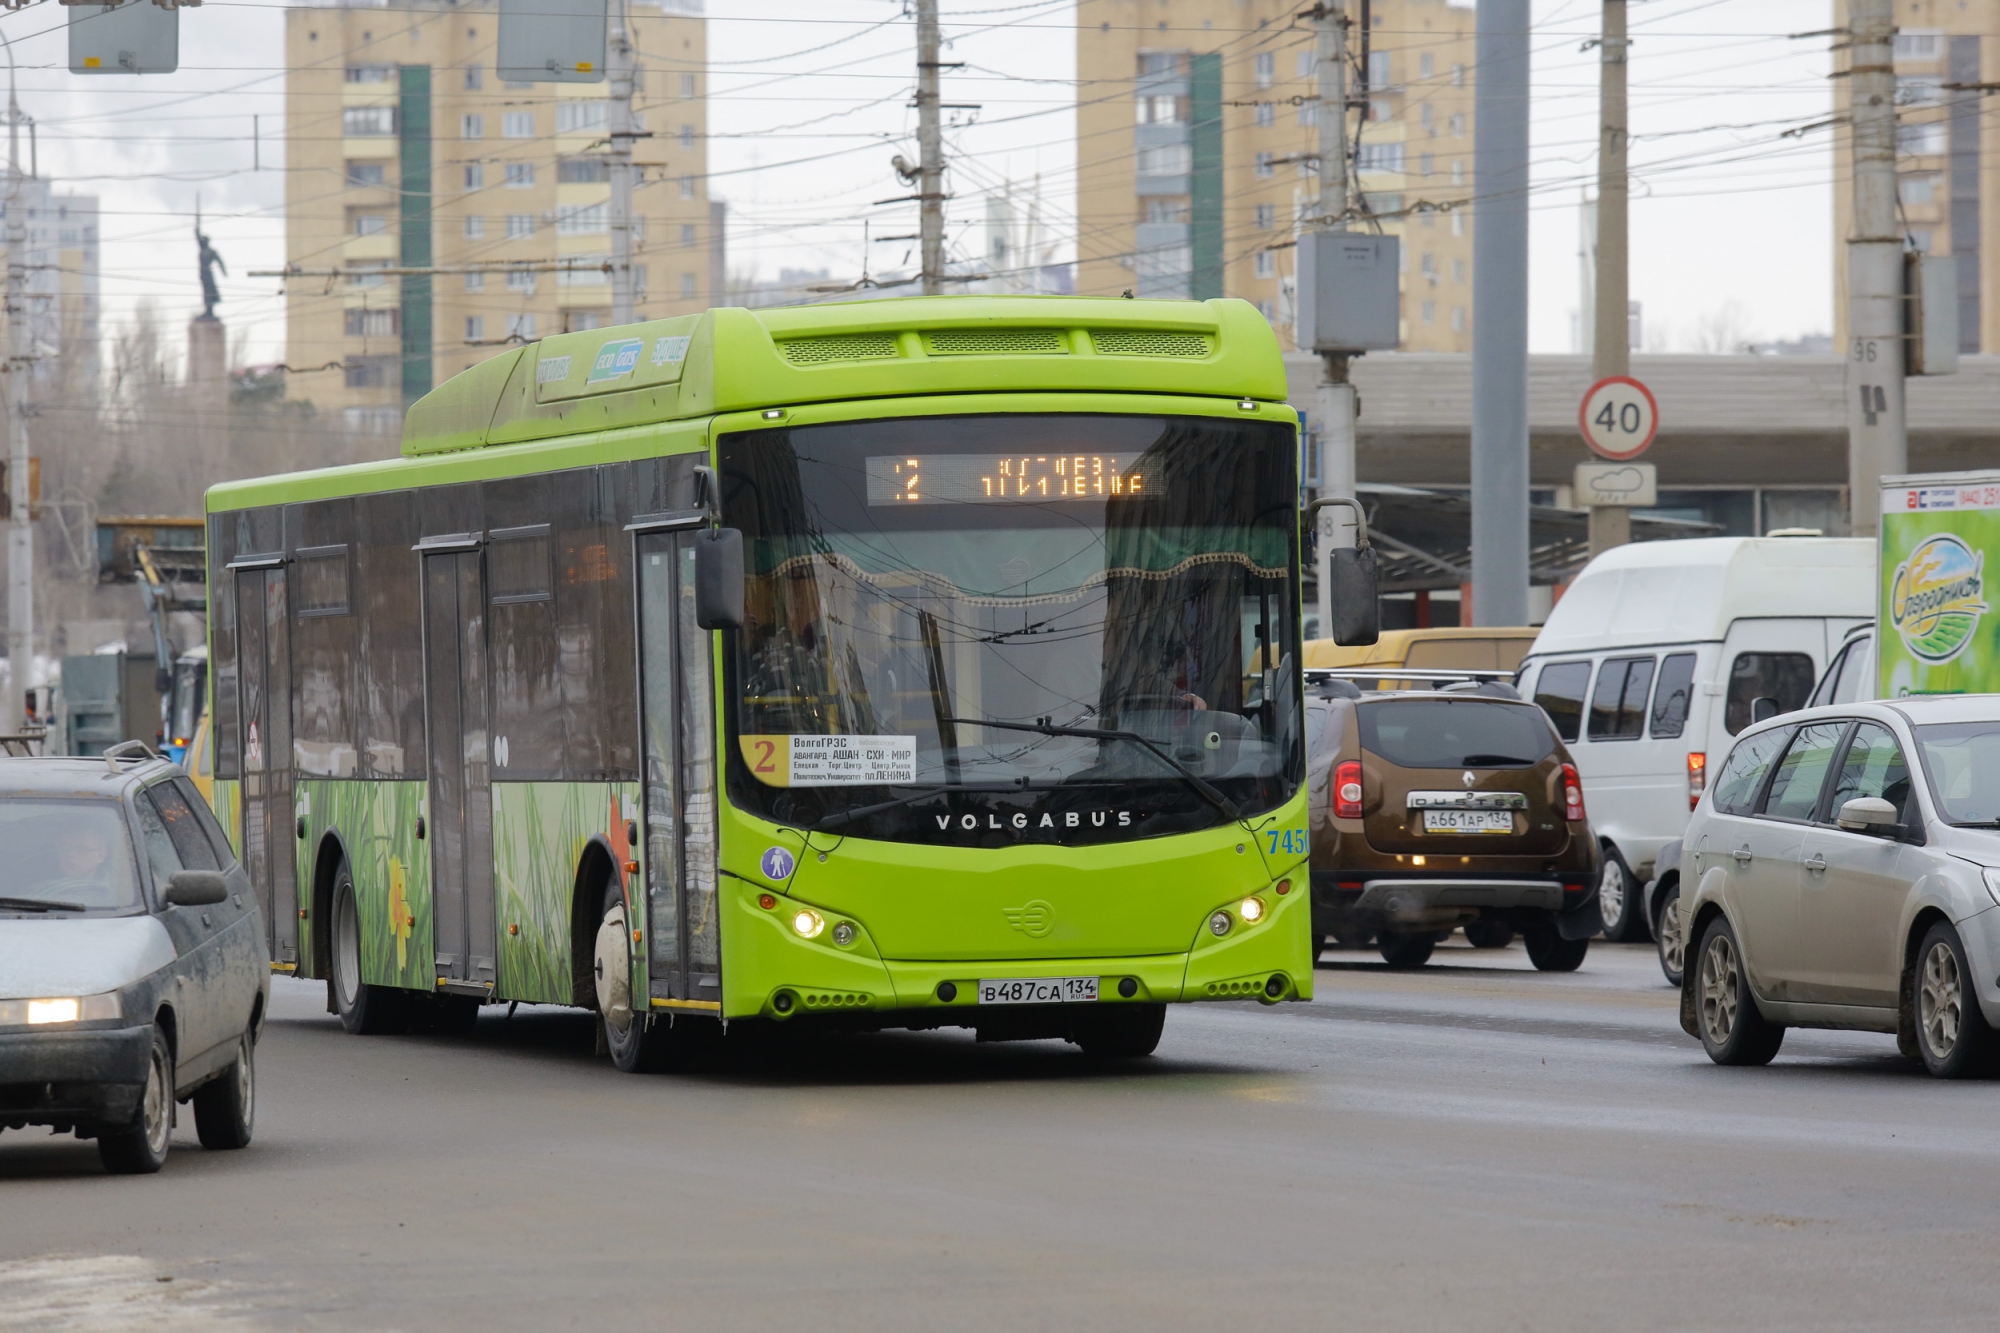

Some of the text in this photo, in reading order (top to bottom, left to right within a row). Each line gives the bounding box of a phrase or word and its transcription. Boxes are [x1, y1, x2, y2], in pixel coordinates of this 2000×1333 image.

[1853, 341, 1877, 363] 96
[596, 353, 615, 370] ECO
[1595, 401, 1640, 434] 40
[794, 737, 846, 748] ВолгоГРЭС
[754, 740, 776, 773] 2
[793, 750, 911, 760] АВАНГАРД АШАН СХИ МИР
[793, 761, 819, 770] Елецкая
[1415, 798, 1524, 806] DUSTER
[936, 811, 1131, 830] VOLGABUS
[1487, 811, 1510, 824] 134
[1065, 979, 1094, 994] 134
